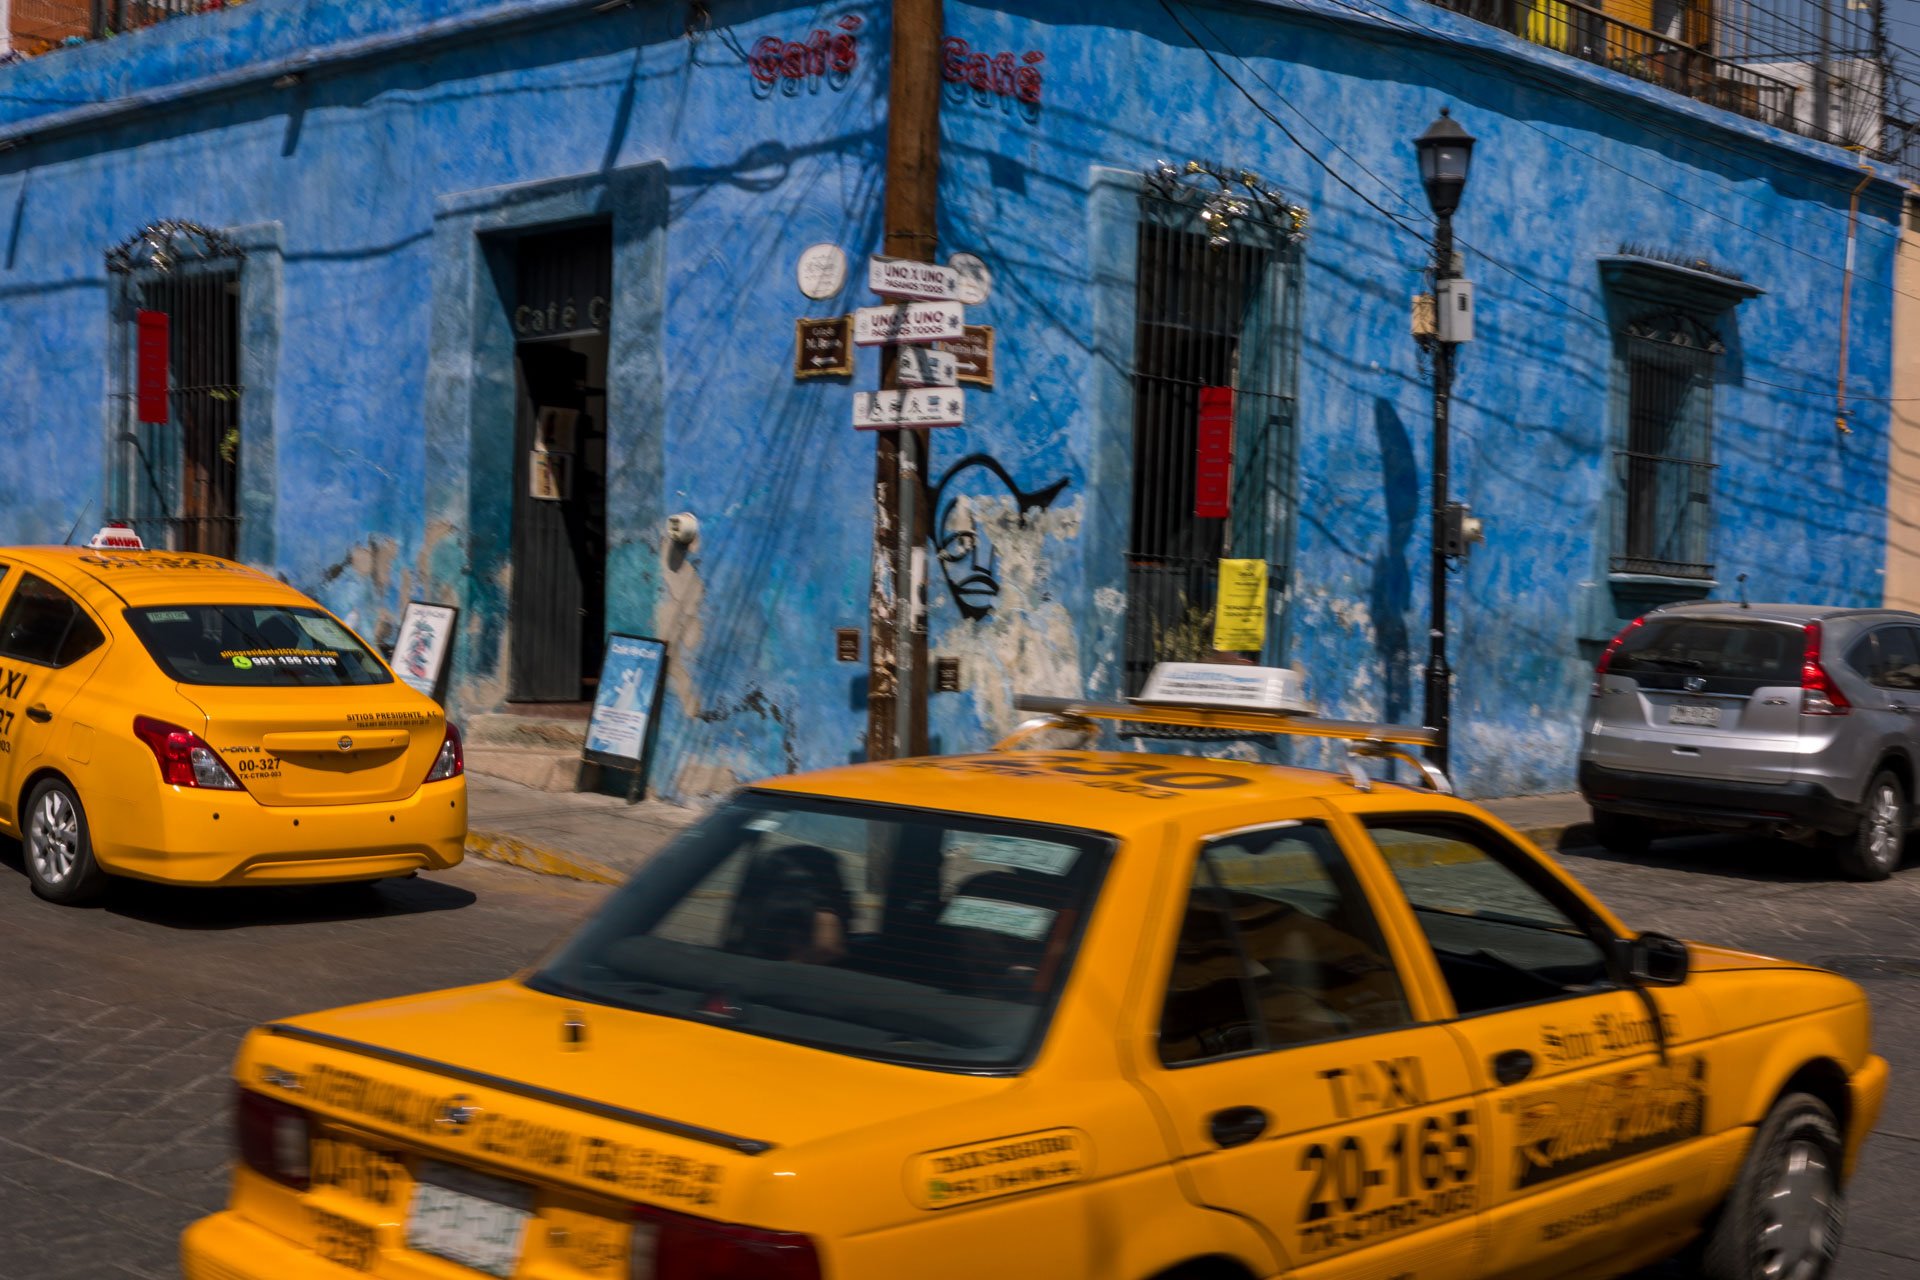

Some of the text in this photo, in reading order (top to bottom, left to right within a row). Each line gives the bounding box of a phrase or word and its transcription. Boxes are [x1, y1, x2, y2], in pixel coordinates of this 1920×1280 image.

[941, 36, 1043, 103] Café
[884, 265, 944, 283] UNO X UNO
[871, 310, 944, 327] UNO X UNO
[252, 656, 276, 666] 951
[0, 667, 28, 699] XI
[346, 713, 374, 721] SITIOS
[239, 757, 281, 772] 00-327
[1317, 1056, 1426, 1120] TAXI
[1296, 1110, 1477, 1225] 20-165
